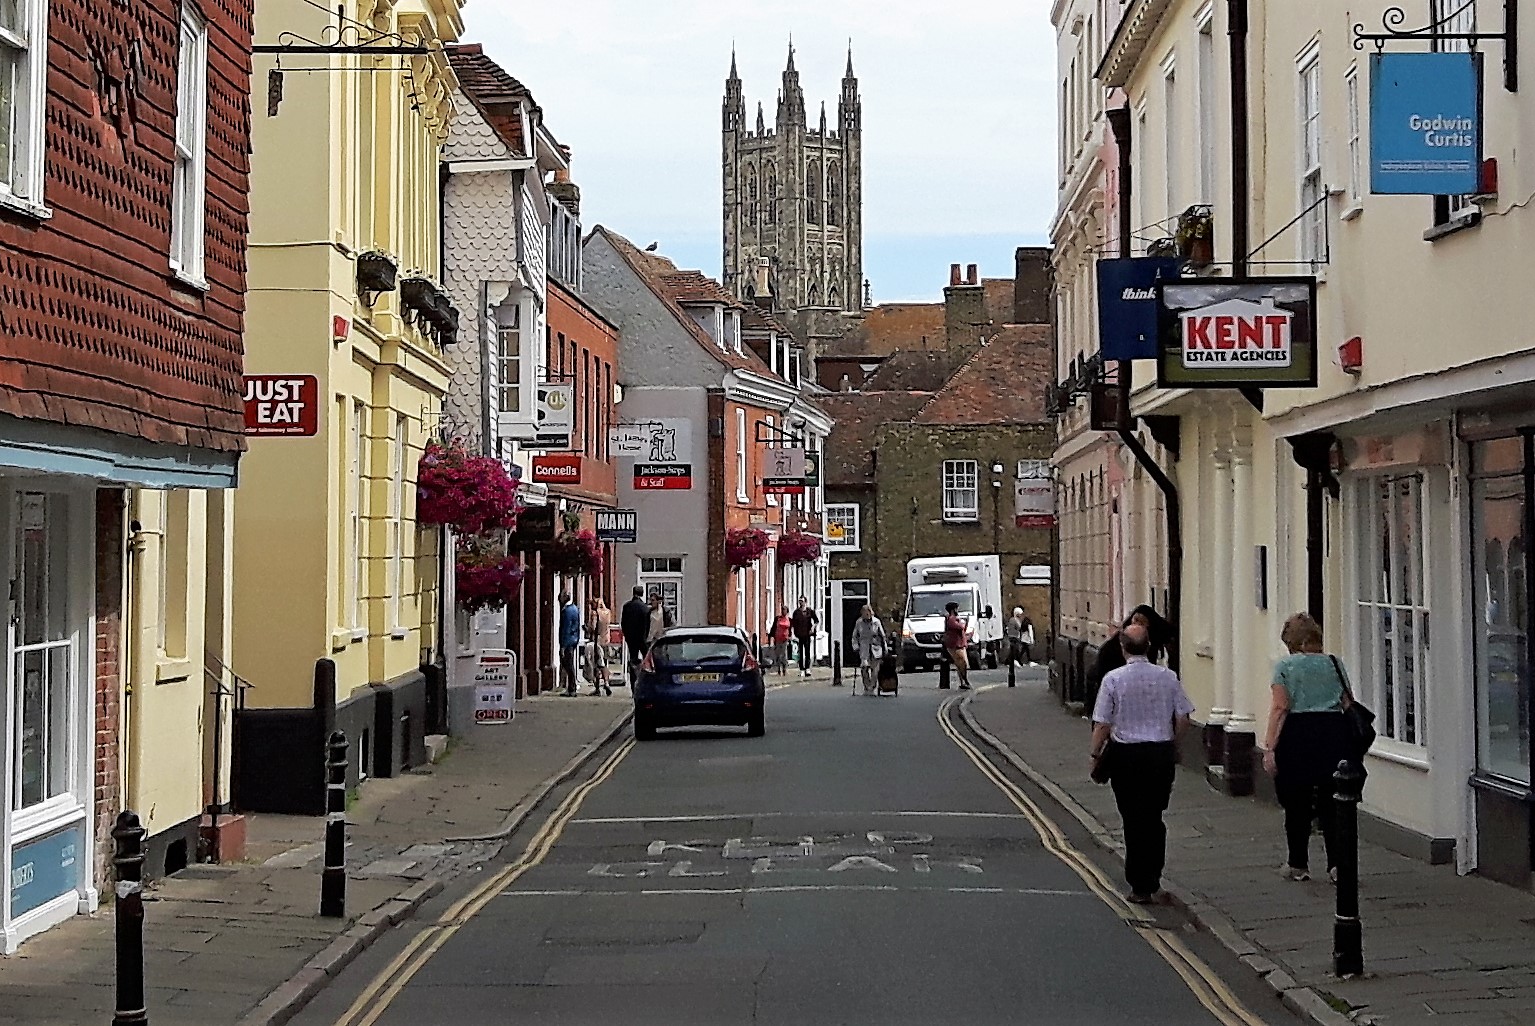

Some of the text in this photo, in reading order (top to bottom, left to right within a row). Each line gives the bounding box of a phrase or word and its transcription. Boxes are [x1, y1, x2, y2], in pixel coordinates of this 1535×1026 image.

[1409, 113, 1472, 131] Godwin
[1425, 131, 1472, 146] Curtis
[1122, 286, 1157, 301] think
[1187, 316, 1287, 349] KENT
[1186, 351, 1287, 362] ESTATE AGENCIES
[243, 380, 304, 401] JUST
[258, 402, 304, 423] EAT
[535, 465, 577, 476] Connells
[597, 513, 635, 530] MANN
